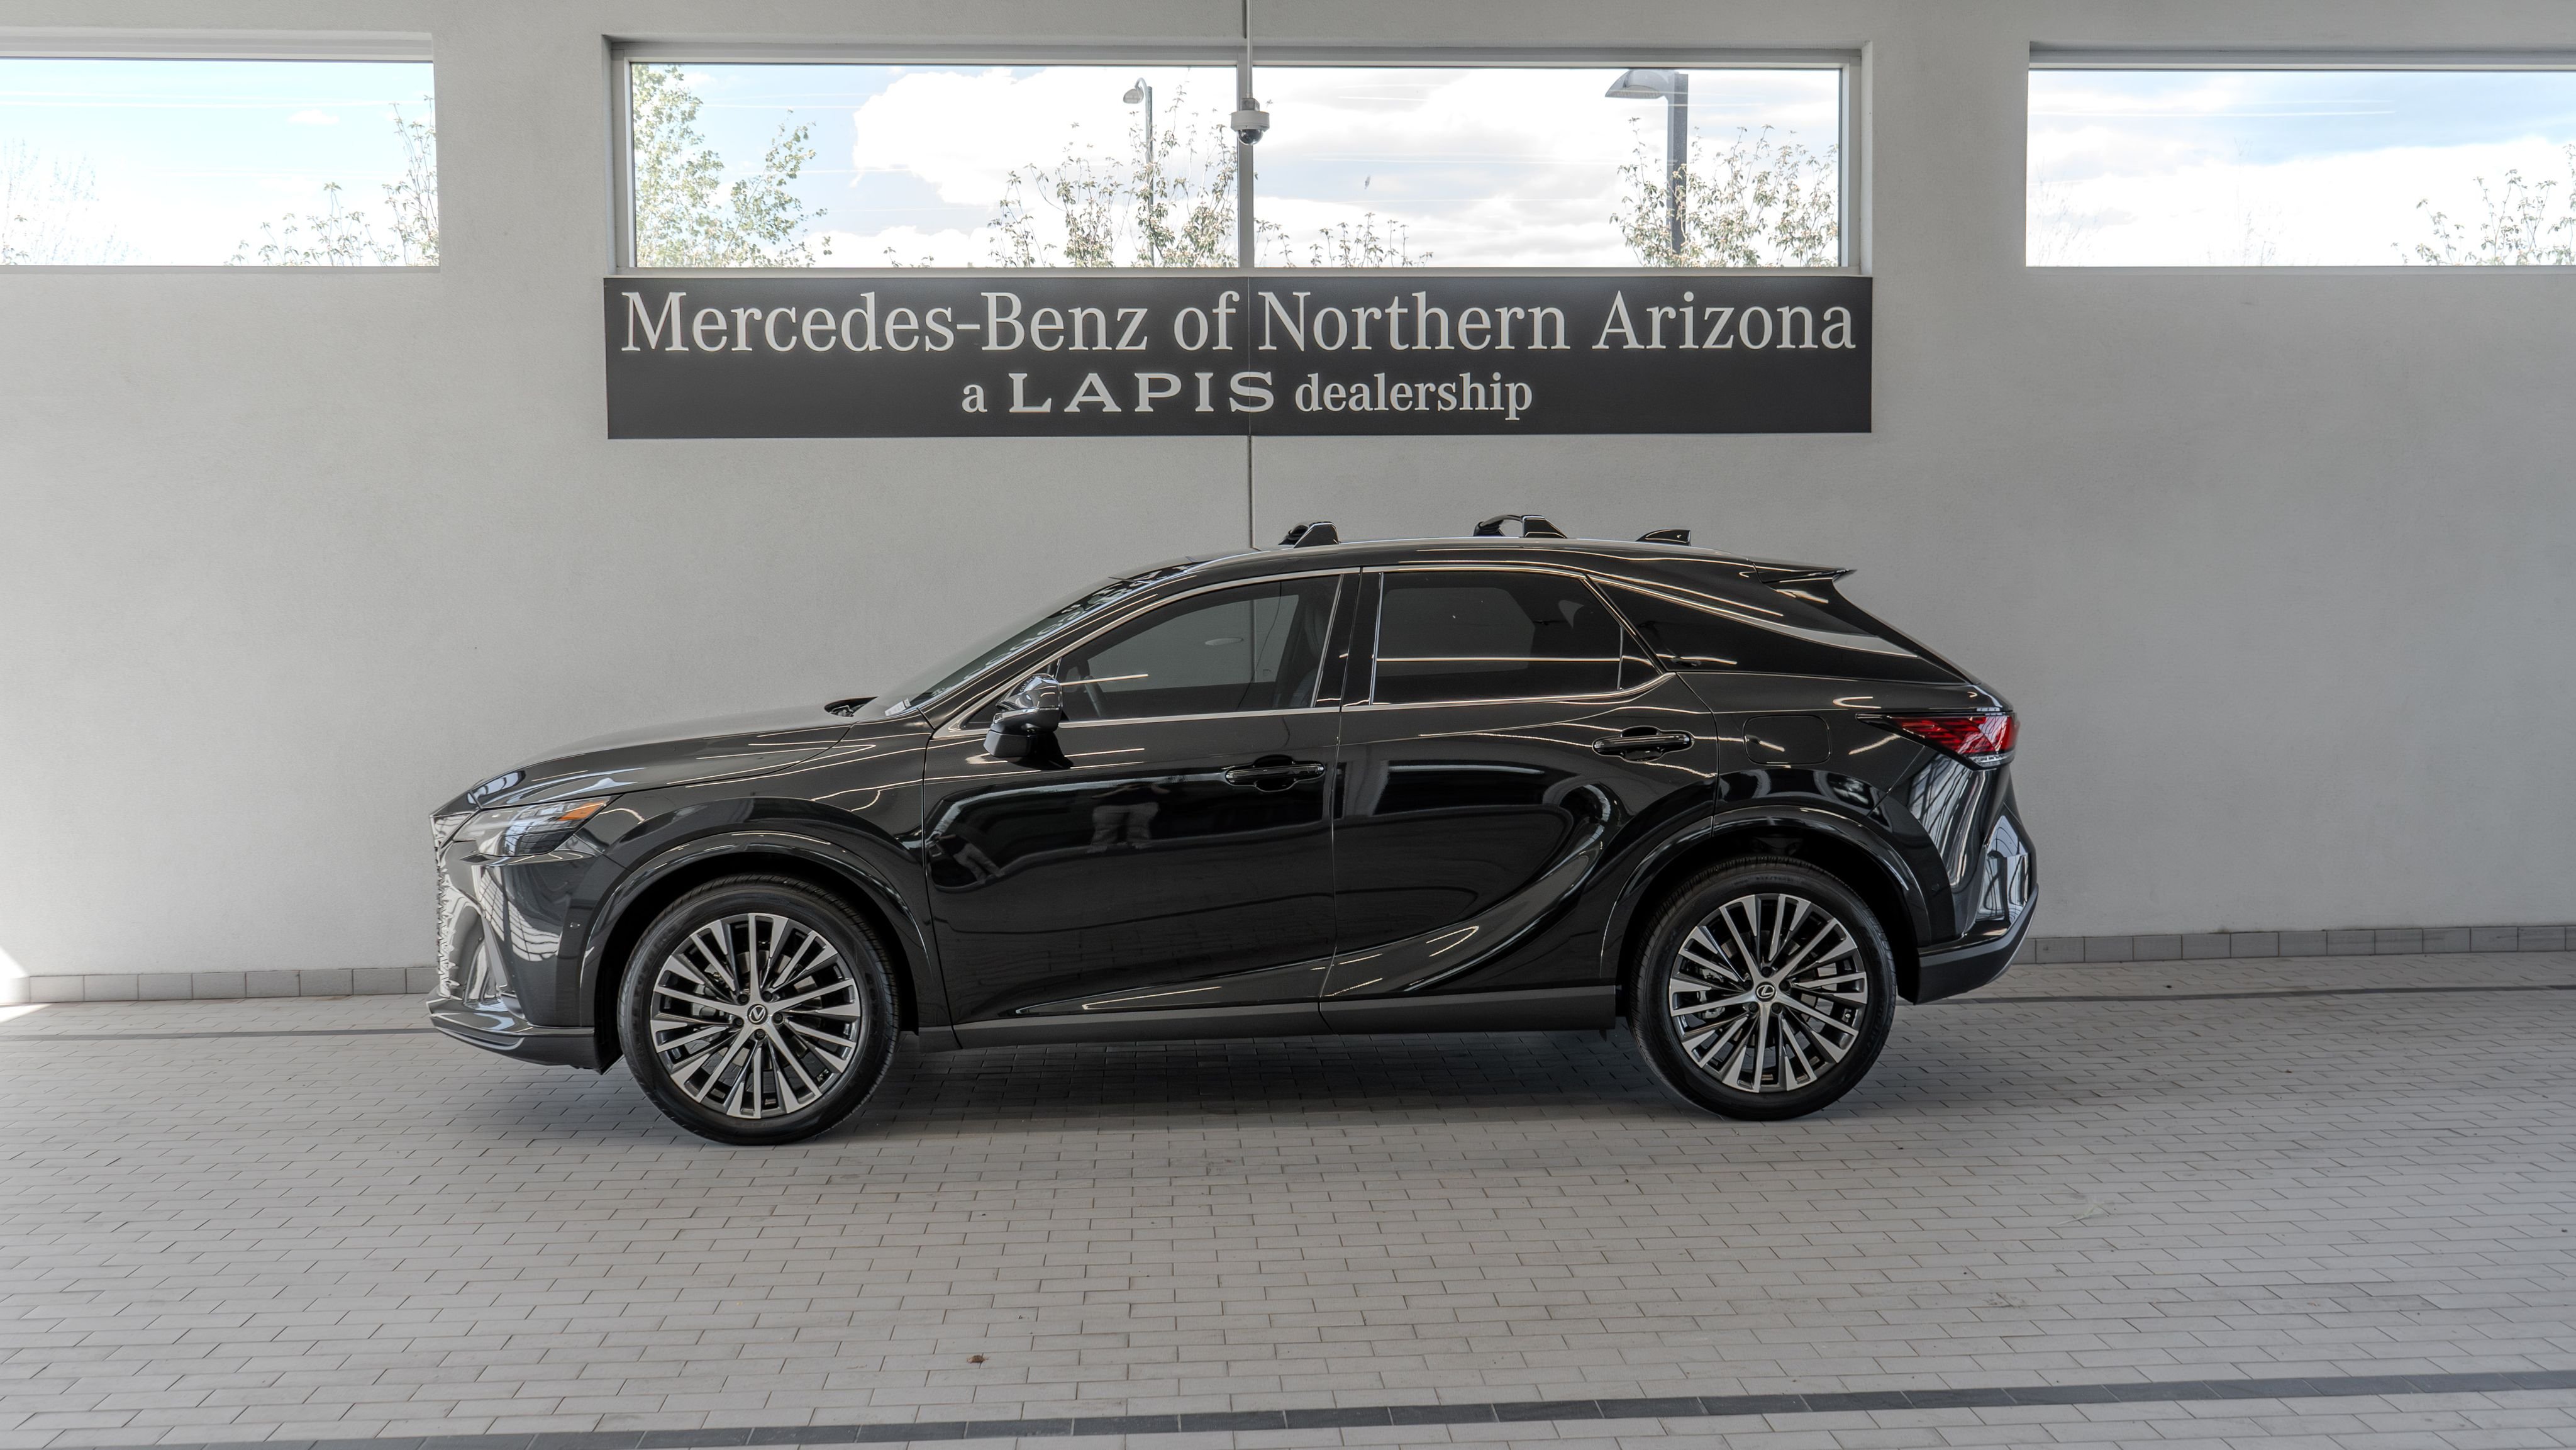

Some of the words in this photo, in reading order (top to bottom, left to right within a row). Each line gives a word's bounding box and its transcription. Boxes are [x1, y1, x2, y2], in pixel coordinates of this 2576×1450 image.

[621, 291, 1148, 352] Mercedes-Benz
[1174, 290, 1240, 351] of
[1258, 291, 1571, 351] Northern
[1592, 290, 1857, 350] Arizona
[962, 384, 988, 413] a
[1008, 372, 1274, 413] LAPIS
[1295, 372, 1532, 421] dealership
